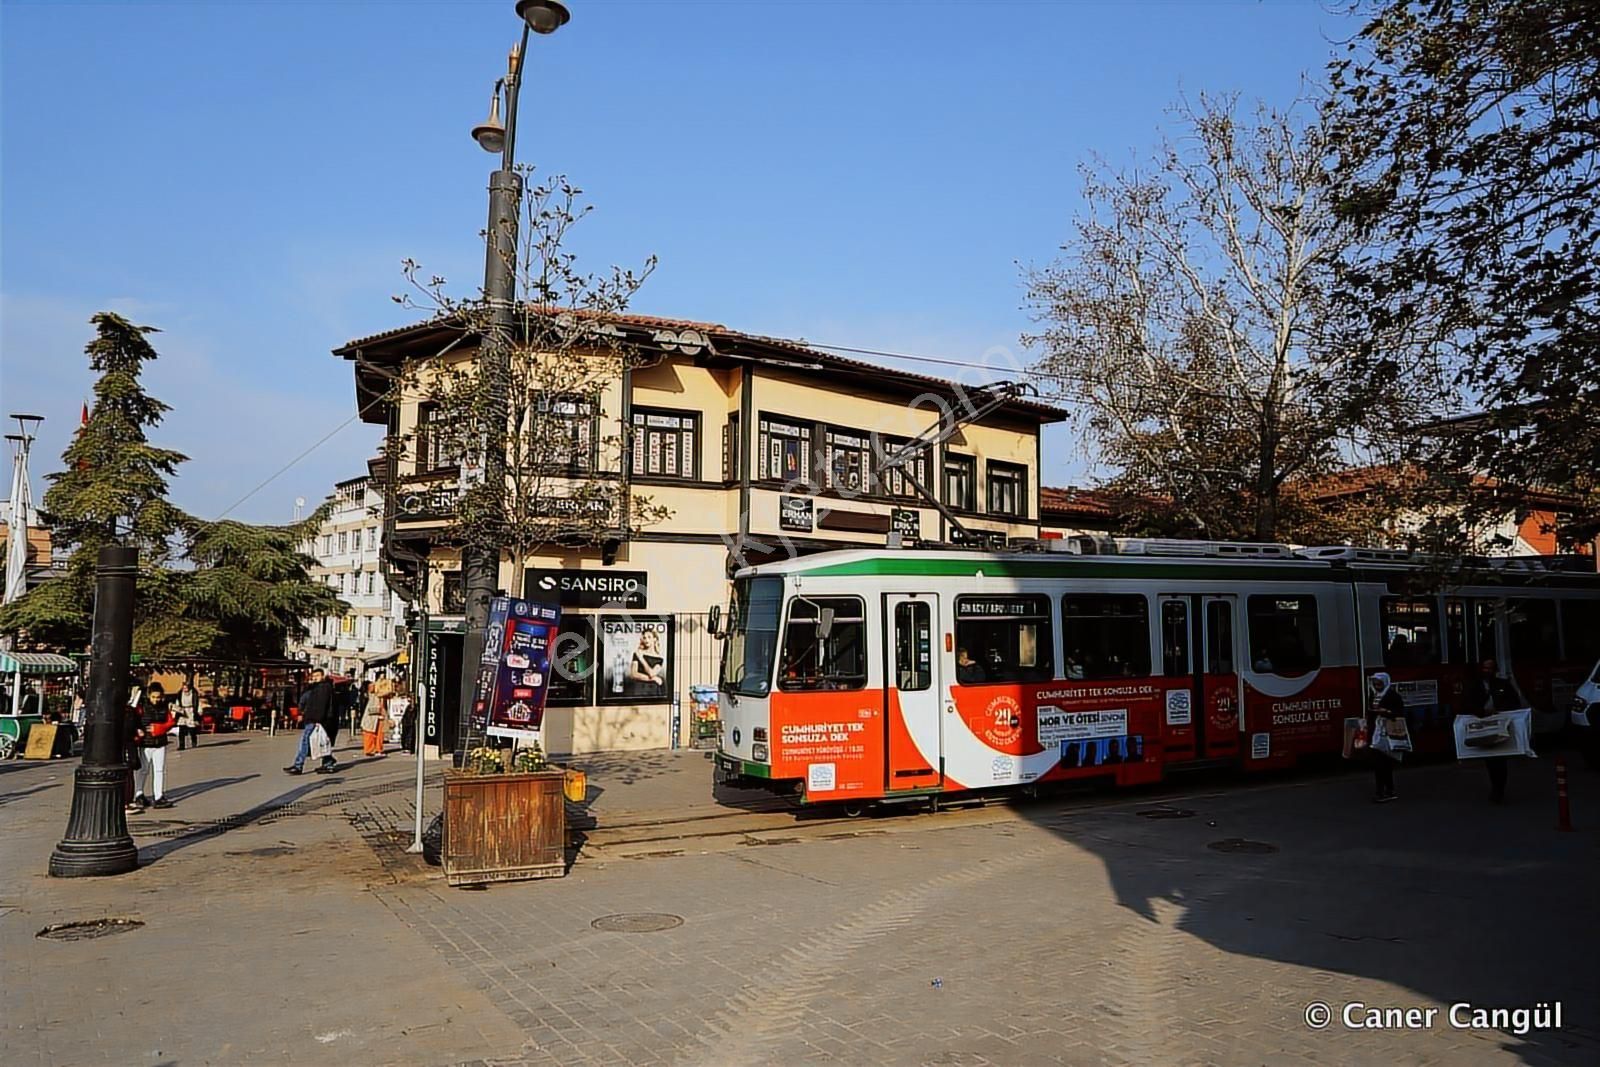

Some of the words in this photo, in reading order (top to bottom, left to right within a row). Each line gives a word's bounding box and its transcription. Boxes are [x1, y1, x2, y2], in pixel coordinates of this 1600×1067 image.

[427, 648, 437, 737] SANSIRO
[1040, 716, 1060, 726] MOR
[1062, 715, 1075, 724] VE
[1076, 711, 1099, 723] ÖTESİ
[782, 722, 843, 734] CUMHURİYET
[848, 723, 864, 732] TEK
[782, 734, 828, 744] SONSUZA
[830, 733, 849, 742] DEK
